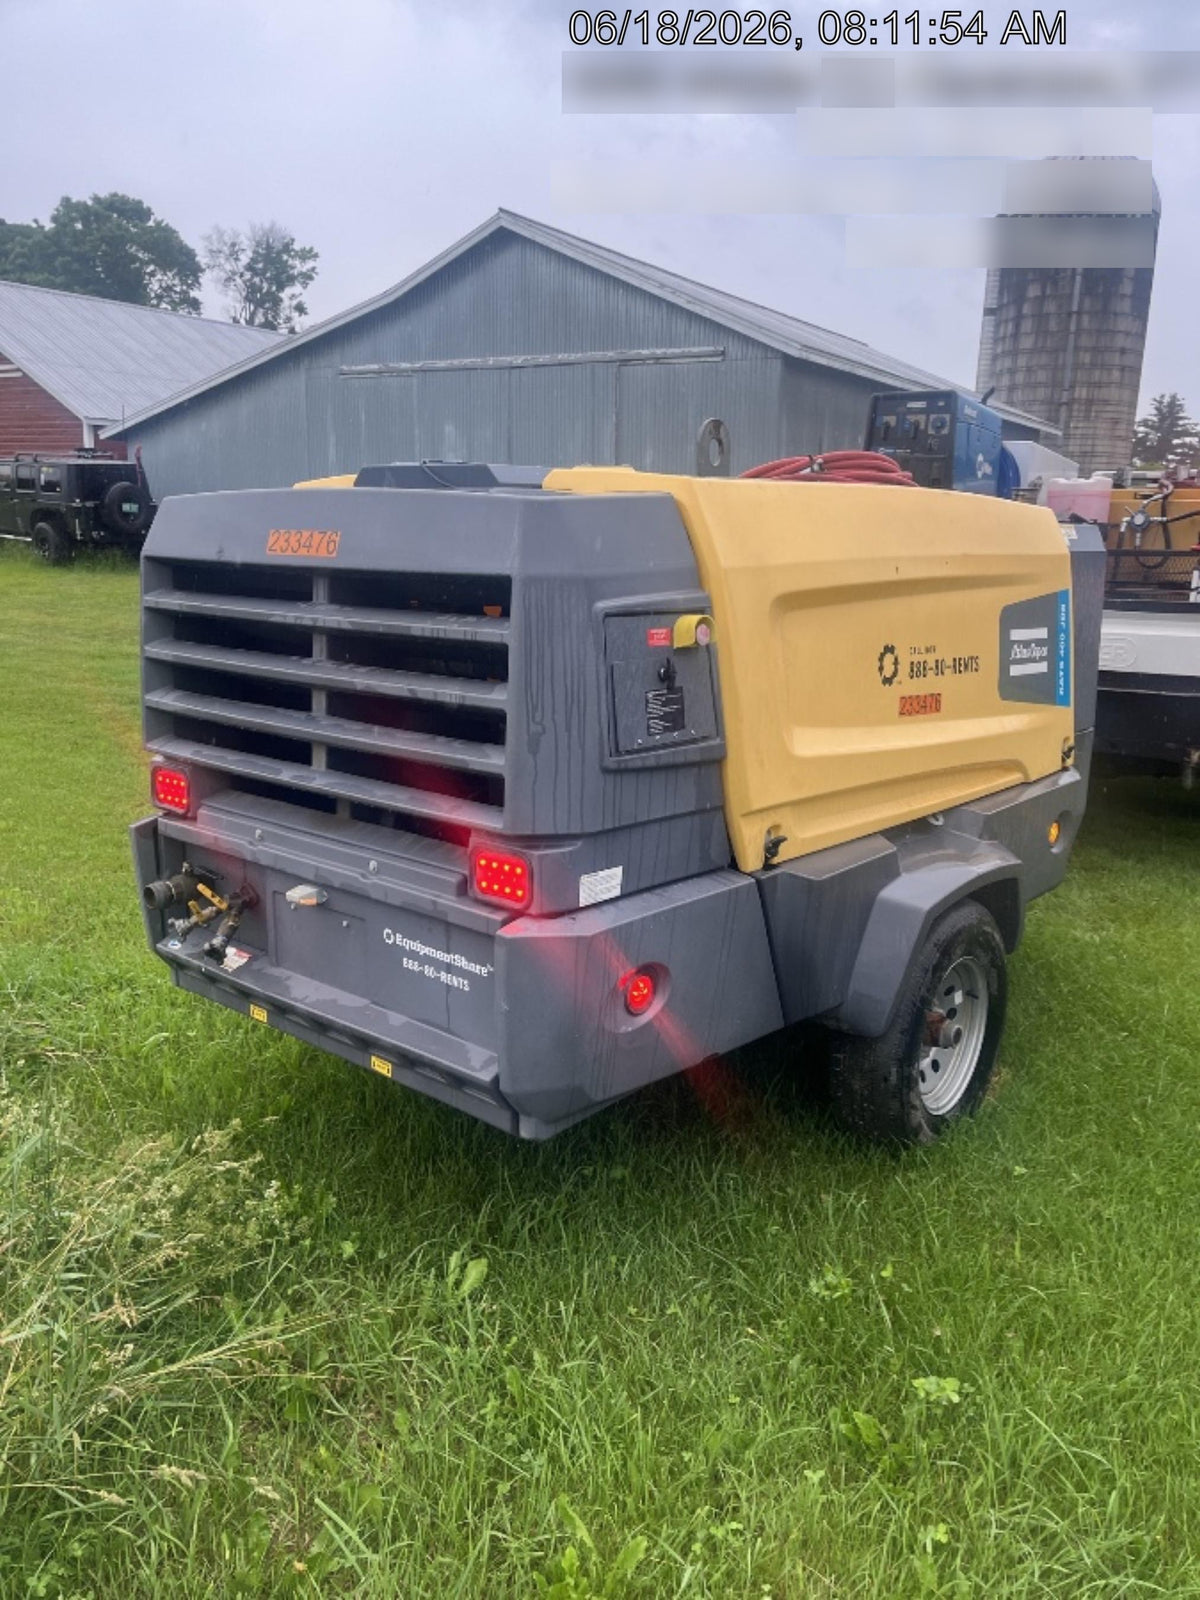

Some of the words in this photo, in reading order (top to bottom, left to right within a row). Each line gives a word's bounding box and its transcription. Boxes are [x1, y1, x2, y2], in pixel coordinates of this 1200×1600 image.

[268, 529, 338, 555] 233476
[908, 655, 979, 679] 888-80-RENTS
[395, 932, 489, 977] EquipmentShare
[403, 957, 470, 991] 888-80-RENTS
